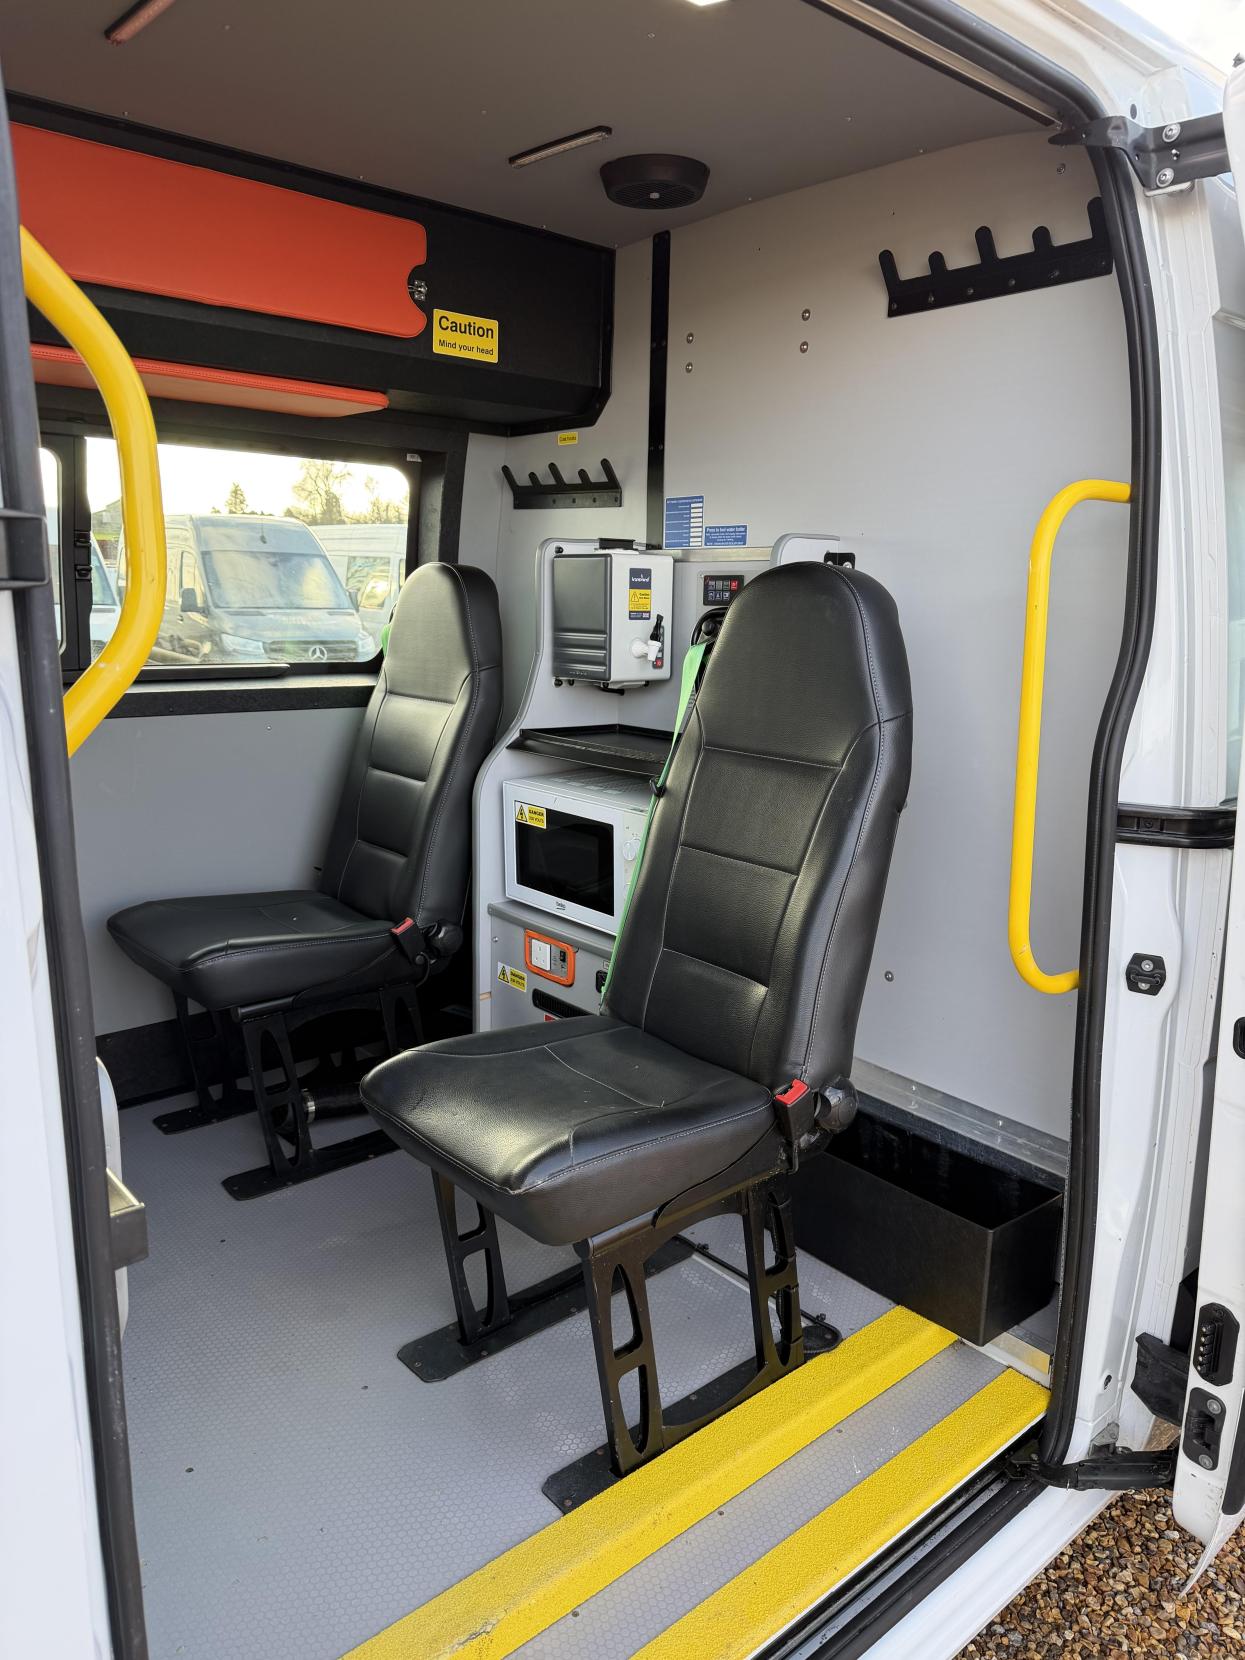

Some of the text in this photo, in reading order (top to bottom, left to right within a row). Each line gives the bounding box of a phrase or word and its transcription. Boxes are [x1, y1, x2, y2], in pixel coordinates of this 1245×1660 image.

[438, 315, 494, 339] Caution
[438, 339, 494, 356] Mind your head
[528, 809, 544, 818] DANGER
[510, 970, 526, 982] DANGER
